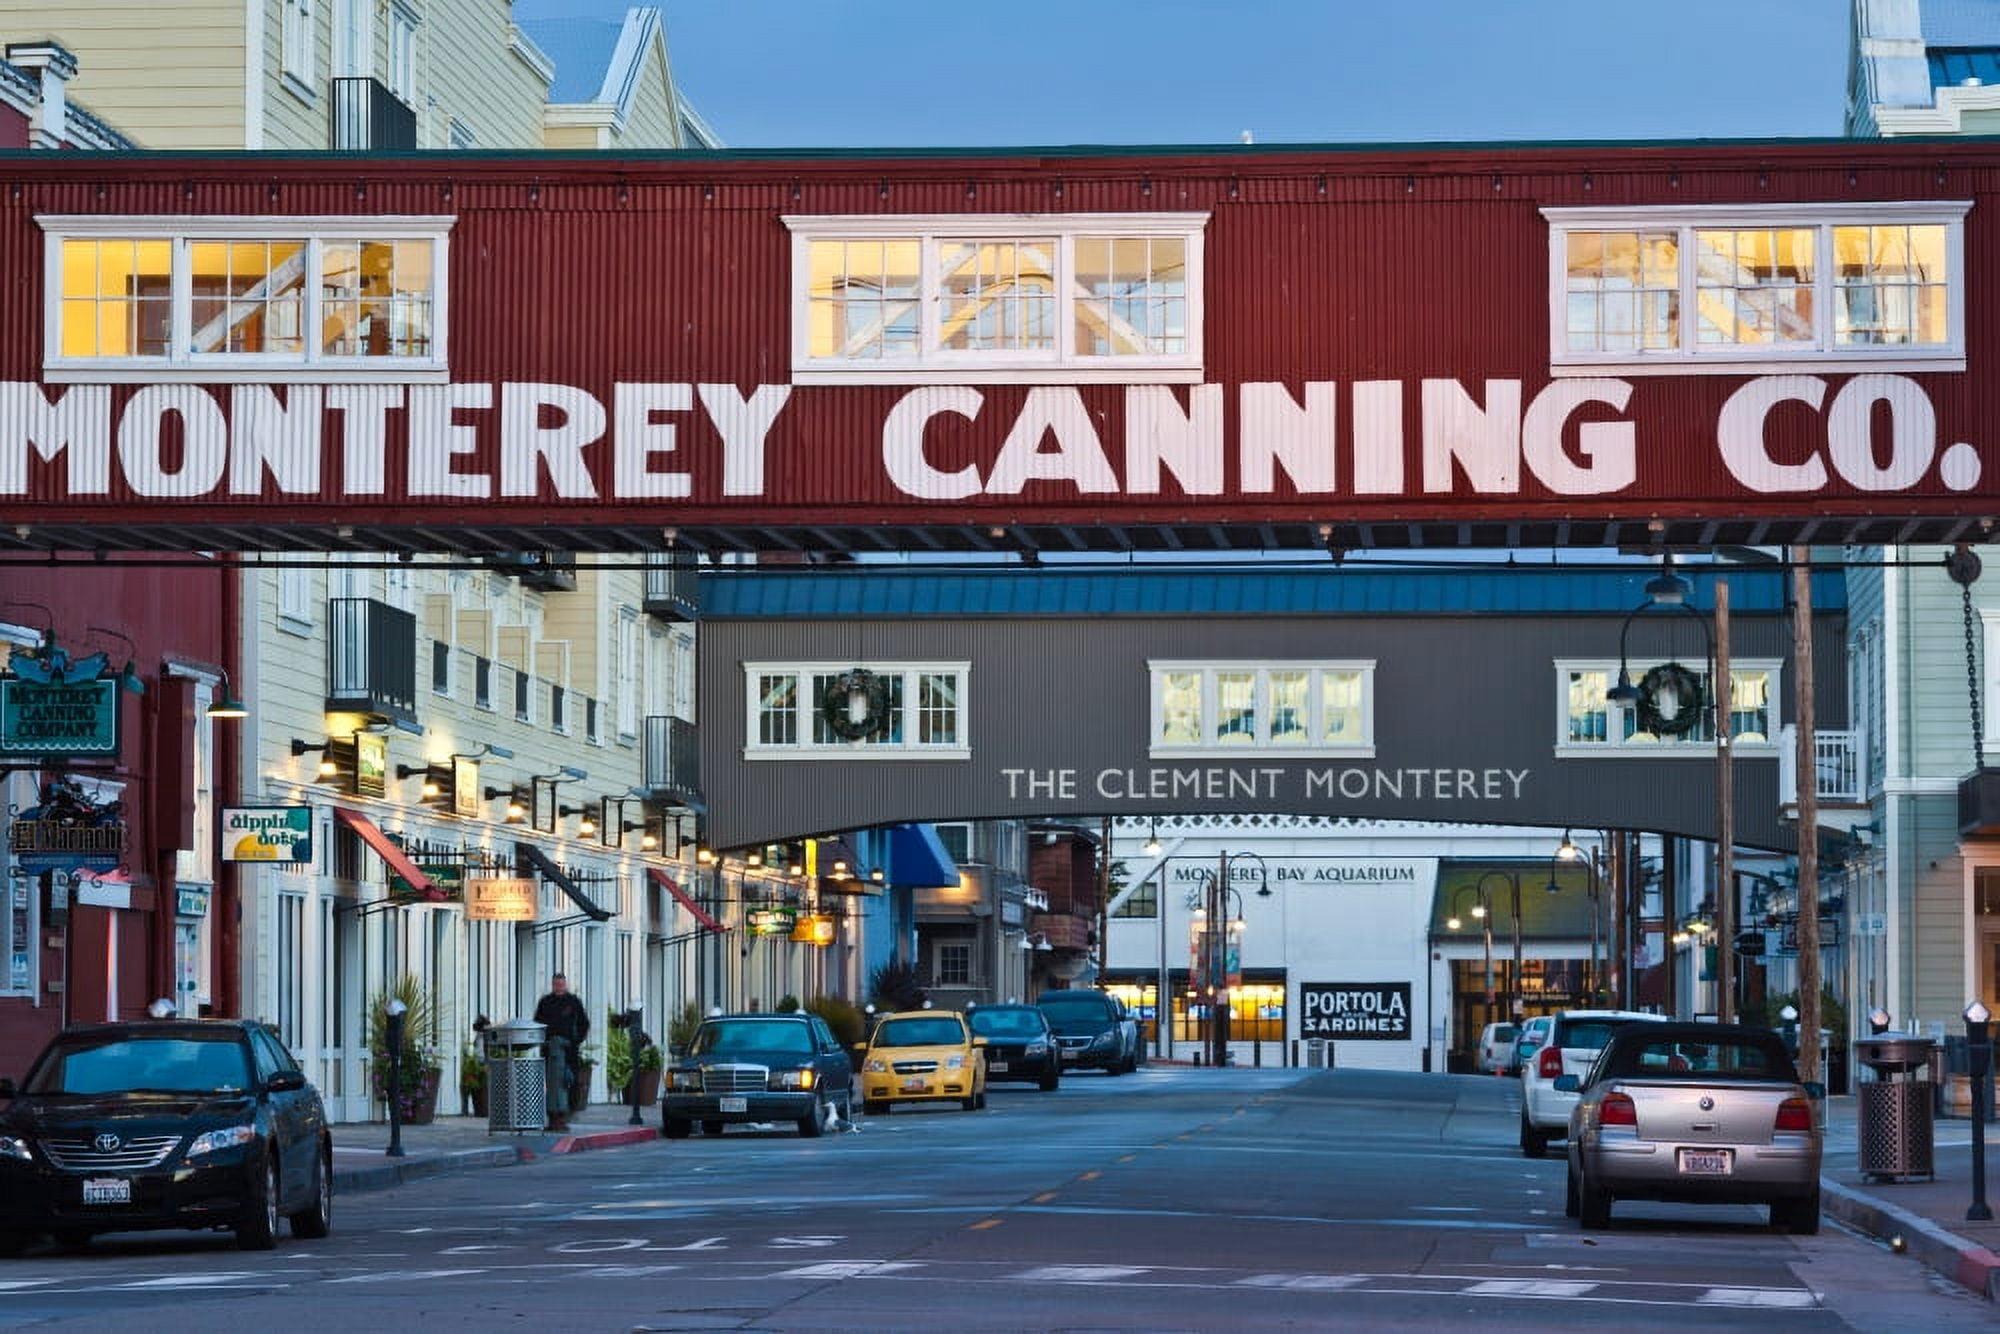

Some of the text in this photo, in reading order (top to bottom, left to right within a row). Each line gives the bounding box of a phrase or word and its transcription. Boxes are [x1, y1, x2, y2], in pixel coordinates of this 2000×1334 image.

[0, 373, 1981, 499] MONTEREY CANNING CO.
[1001, 768, 1530, 800] THE CLEMENT MONTEREY
[1277, 867, 1306, 881] BAY
[1314, 867, 1415, 882] AQUARIUM
[1304, 991, 1407, 1017] PORTOLA
[1304, 1018, 1405, 1032] SARDINES
